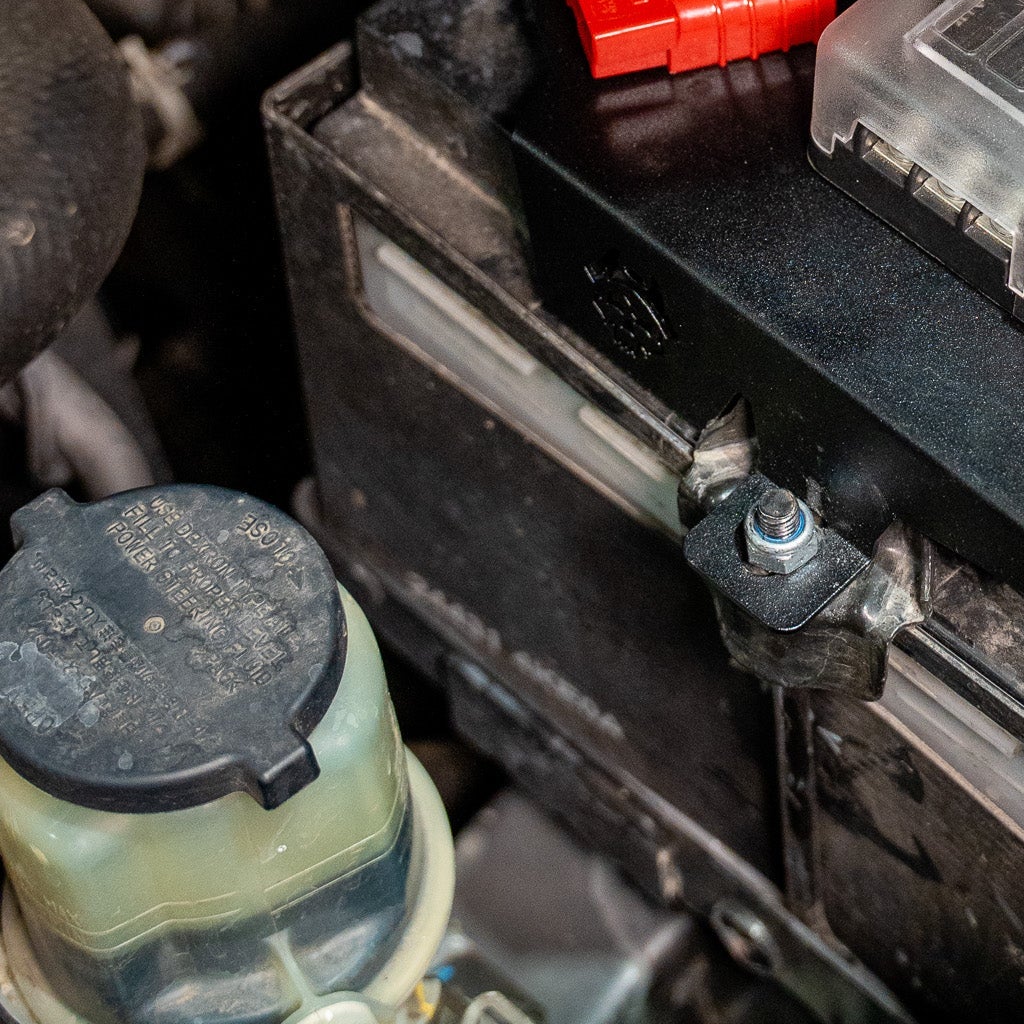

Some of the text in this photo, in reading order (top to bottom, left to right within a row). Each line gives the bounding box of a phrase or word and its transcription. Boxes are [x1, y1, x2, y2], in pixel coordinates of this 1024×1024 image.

[122, 502, 292, 673] FILL TO PROPER LEVEL
[147, 493, 182, 528] USE
[172, 519, 236, 582] DEXRON
[235, 512, 298, 568] CLOSE
[105, 518, 275, 689] POWER STEERING FLUID
